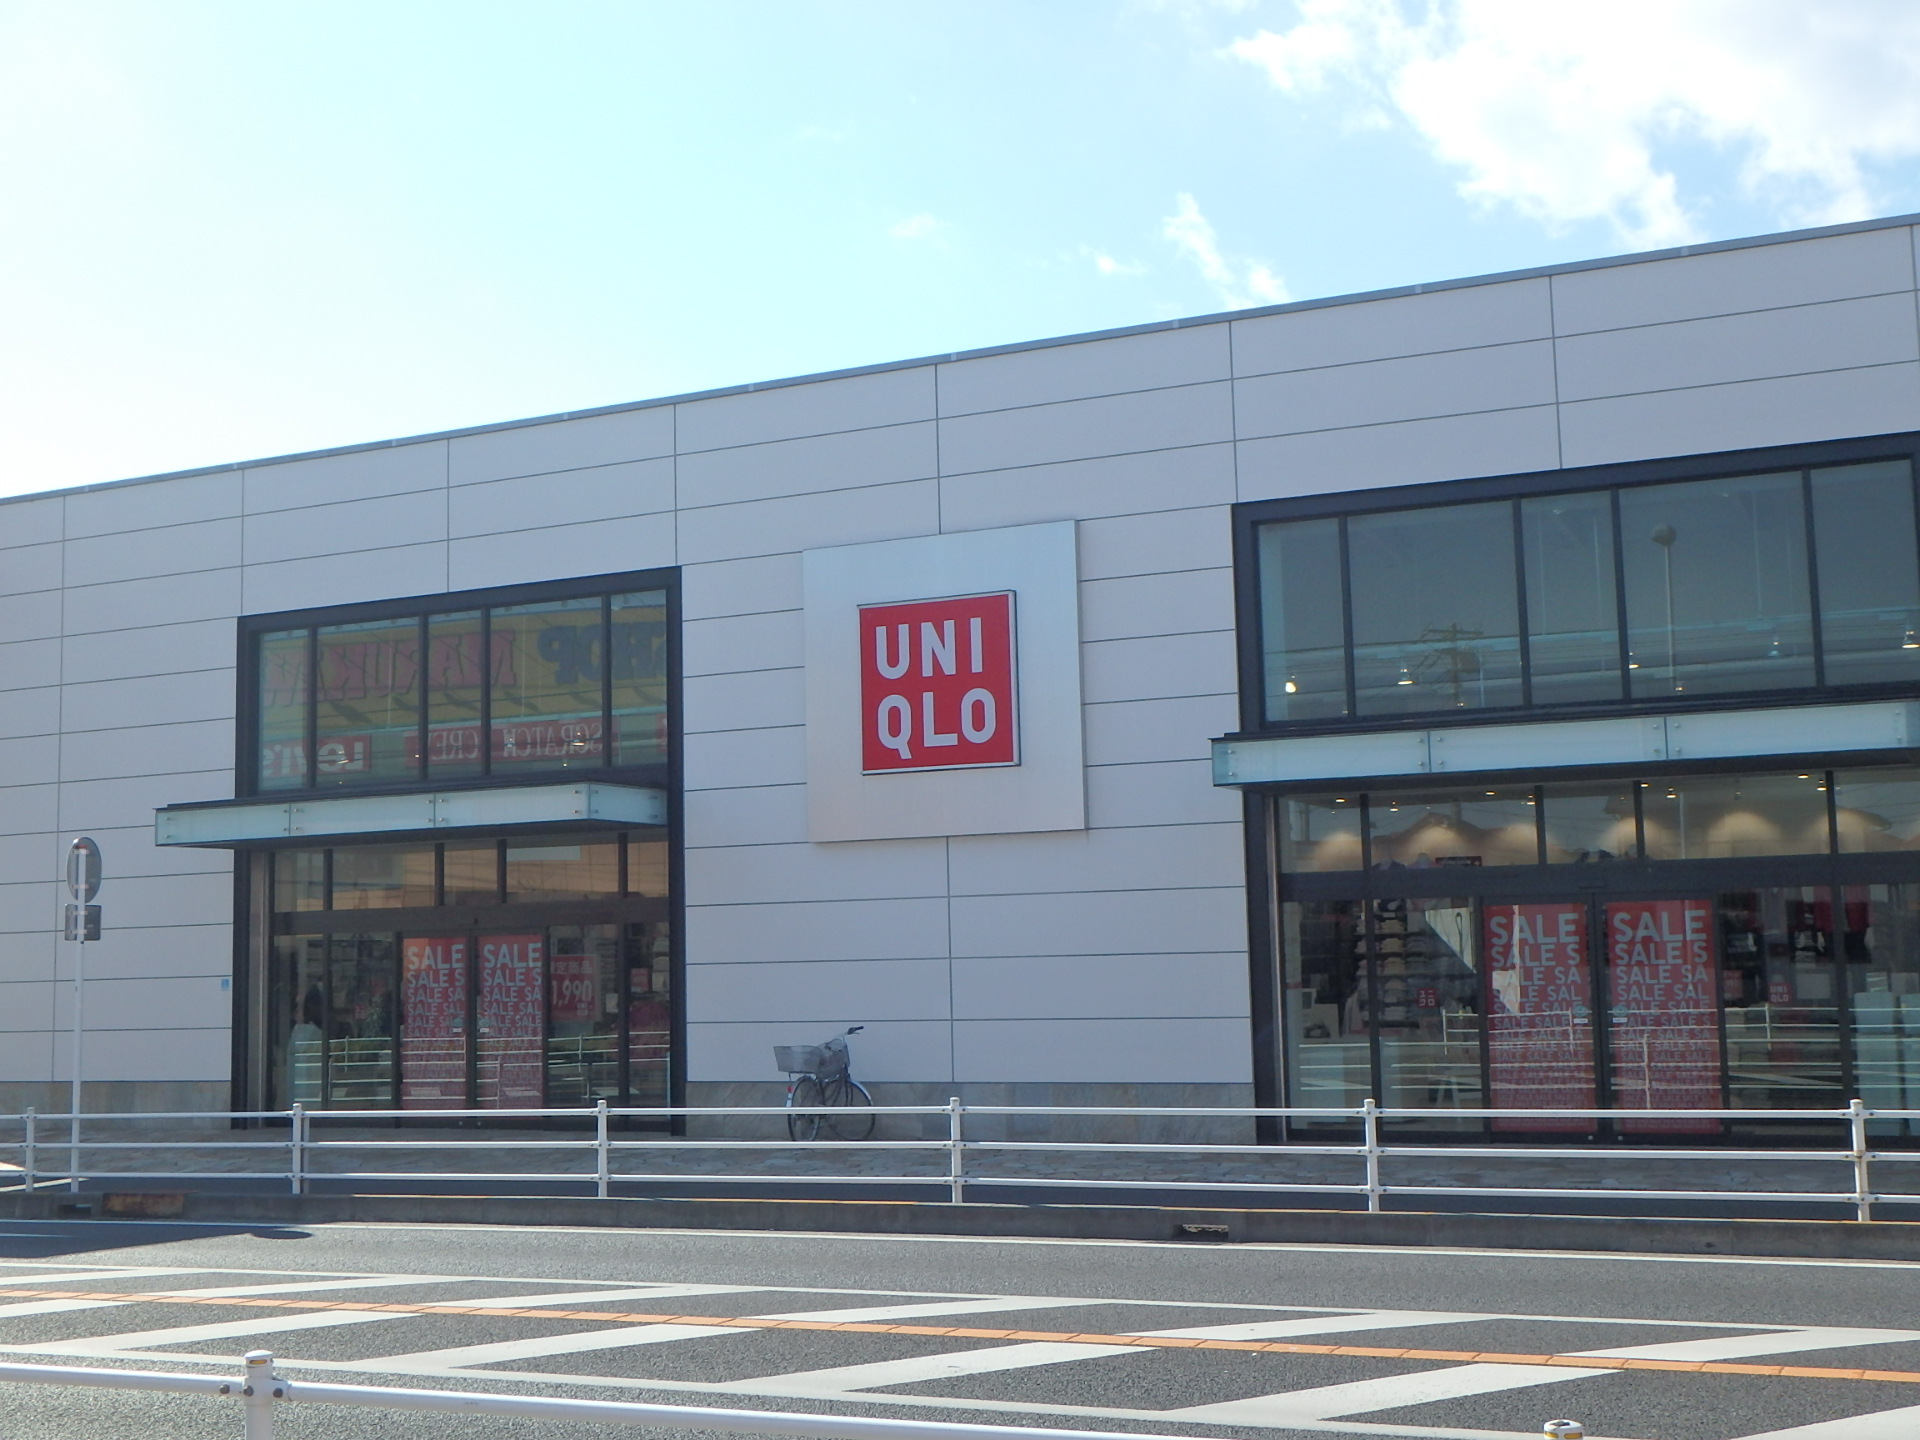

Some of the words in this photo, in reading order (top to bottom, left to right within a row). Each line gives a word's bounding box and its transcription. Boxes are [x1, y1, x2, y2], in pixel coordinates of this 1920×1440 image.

[875, 617, 983, 680] UNI
[877, 687, 996, 759] QLO
[1490, 913, 1580, 945] SALE
[1613, 909, 1707, 942] SALE
[407, 944, 464, 969] SALE
[483, 943, 542, 968] SALE
[1491, 944, 1556, 967] SALE
[1566, 943, 1580, 965] S
[1615, 942, 1683, 965] SALE
[1693, 941, 1708, 963] S
[551, 960, 593, 974] 定商品
[1555, 966, 1582, 984] SA
[1616, 965, 1672, 984] SALE
[1681, 965, 1709, 982] SA
[407, 969, 449, 988] SALE
[455, 969, 465, 986] S
[483, 968, 526, 986] SALE
[407, 988, 443, 1003] SALE
[483, 986, 519, 1002] SALE
[1617, 984, 1666, 1001] SALE
[1673, 983, 1709, 999] SAL
[407, 1003, 438, 1016] SALE
[484, 1002, 514, 1015] SALE
